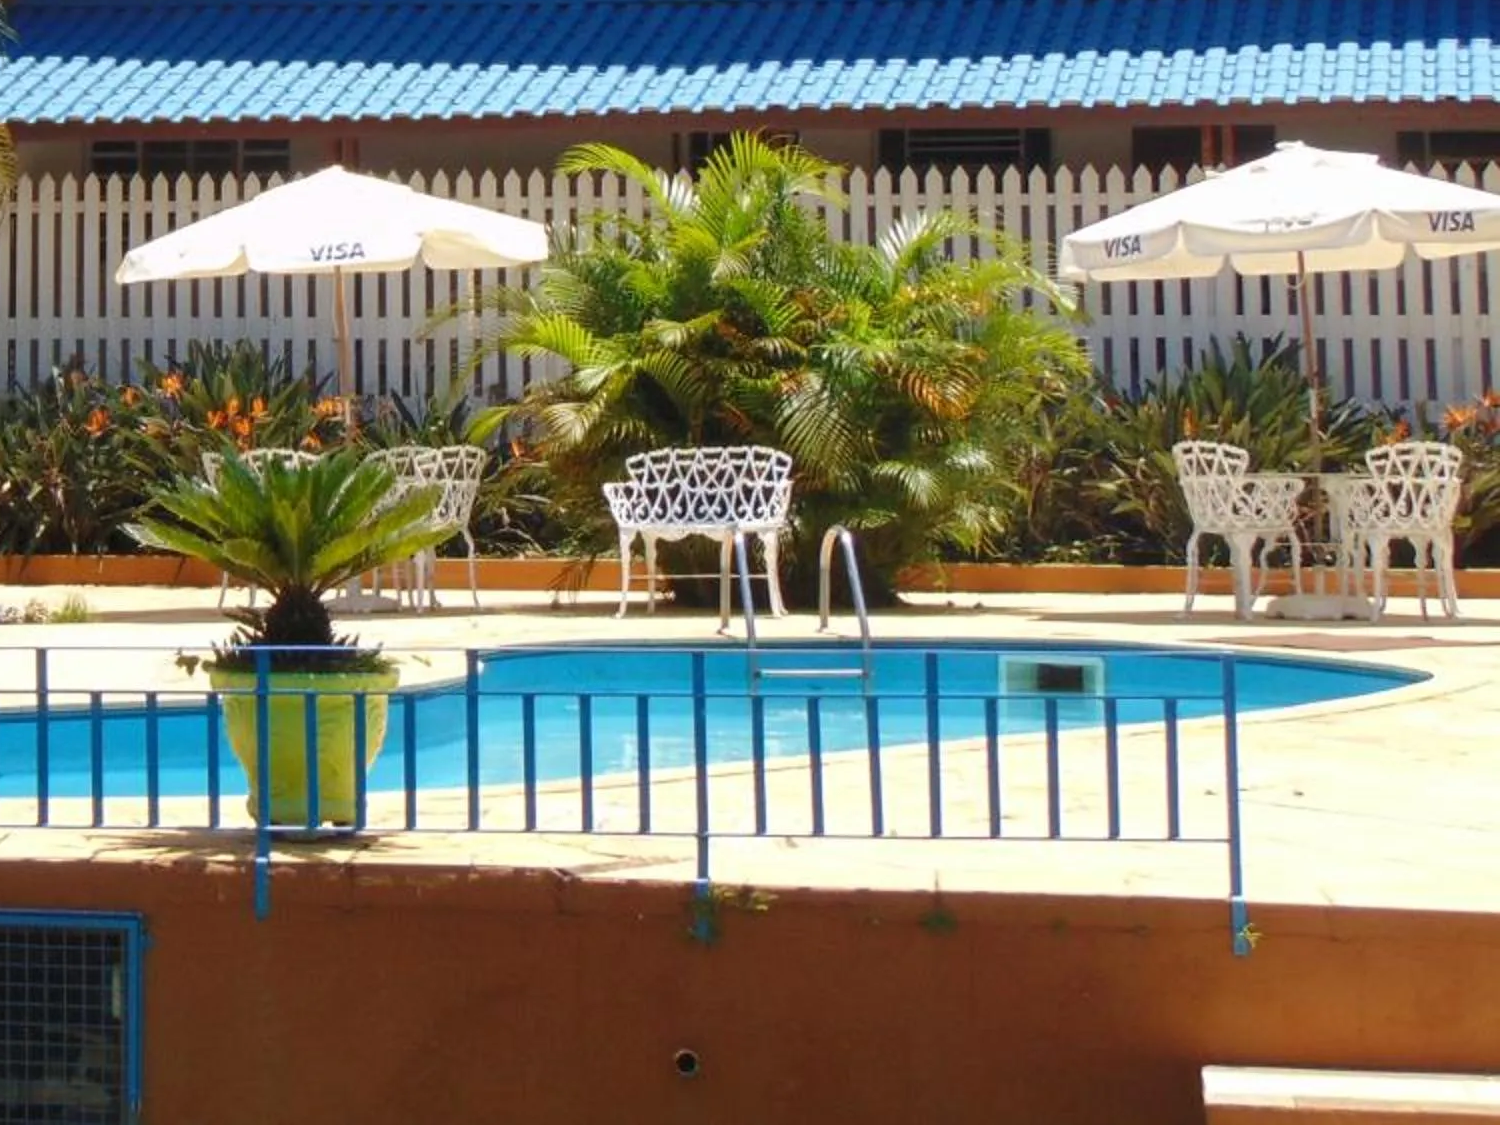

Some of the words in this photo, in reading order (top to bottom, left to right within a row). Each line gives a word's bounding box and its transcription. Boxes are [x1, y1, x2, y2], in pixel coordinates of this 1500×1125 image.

[1429, 211, 1475, 232] VISA
[310, 242, 364, 261] VISA
[1104, 234, 1141, 258] VISA
